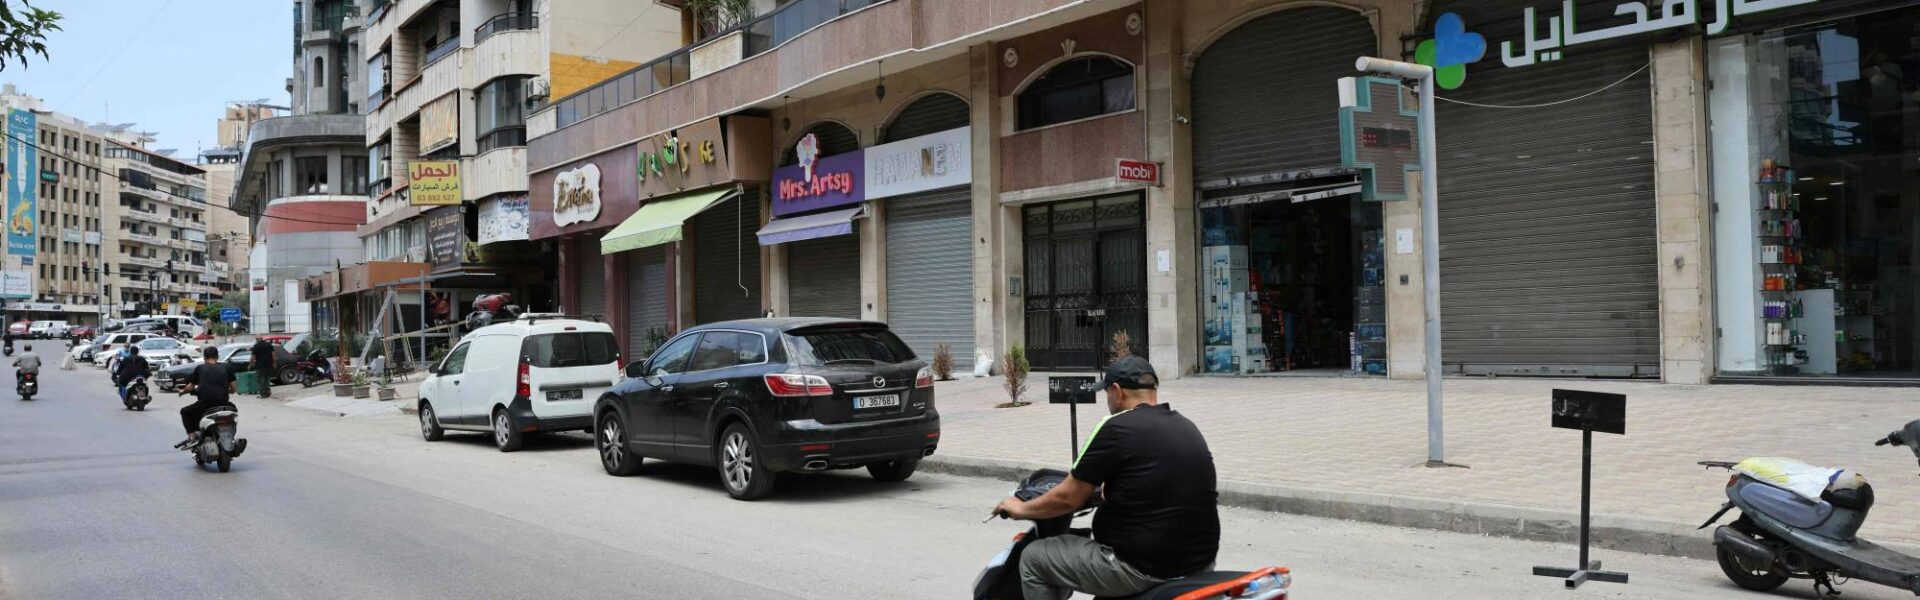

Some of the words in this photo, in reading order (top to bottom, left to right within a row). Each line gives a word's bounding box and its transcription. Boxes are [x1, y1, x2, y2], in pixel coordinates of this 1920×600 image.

[411, 163, 457, 182] الجمل
[412, 183, 440, 191] السيارات
[441, 182, 458, 191] فرش
[779, 179, 808, 202] Mrs.
[810, 171, 853, 197] Artsy
